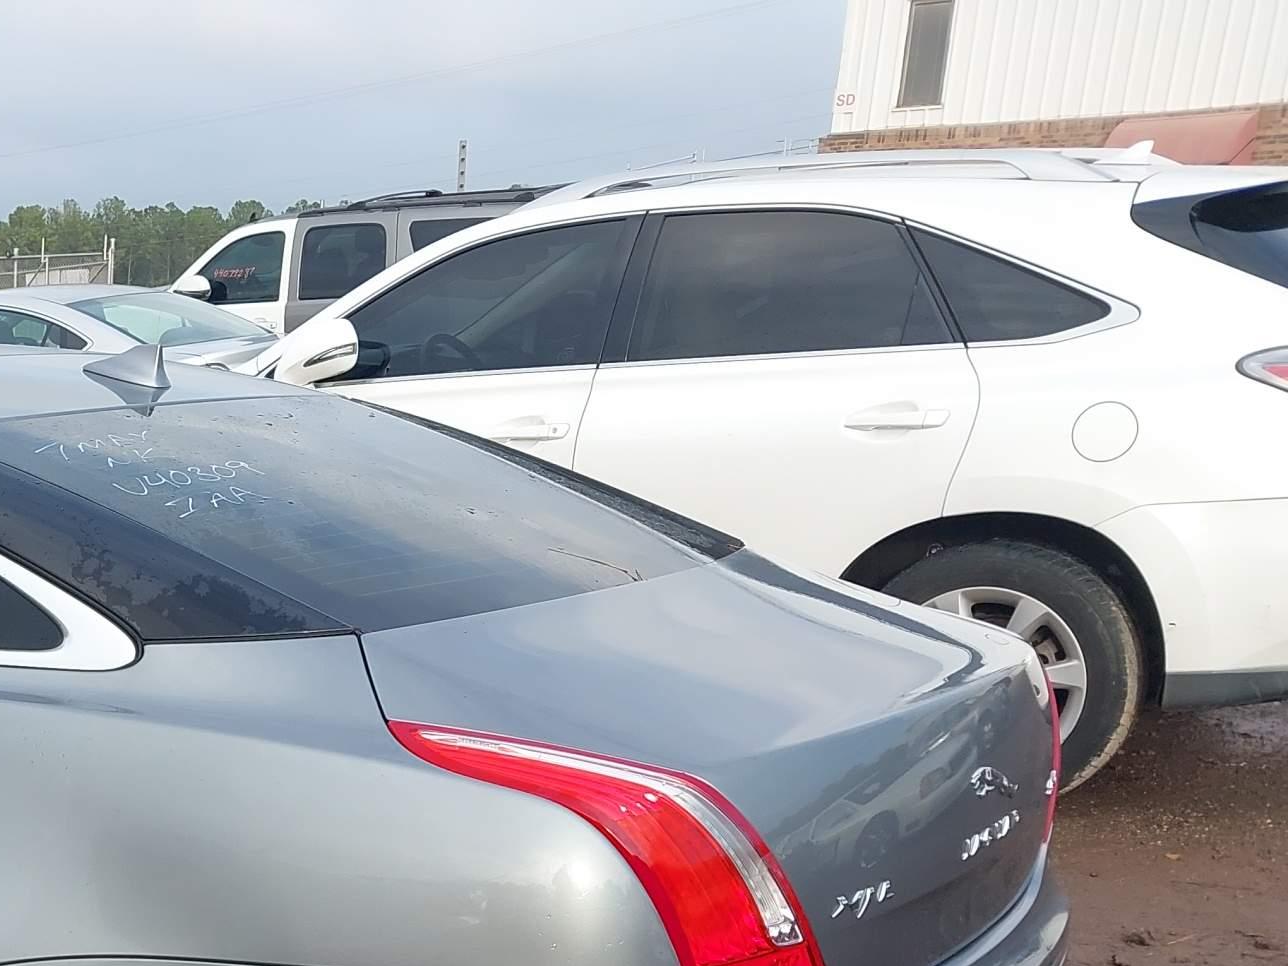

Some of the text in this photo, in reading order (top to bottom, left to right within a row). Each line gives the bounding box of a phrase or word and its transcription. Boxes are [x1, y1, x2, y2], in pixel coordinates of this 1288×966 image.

[836, 94, 856, 107] SD
[111, 459, 266, 497] U40309
[163, 485, 270, 519] IAA
